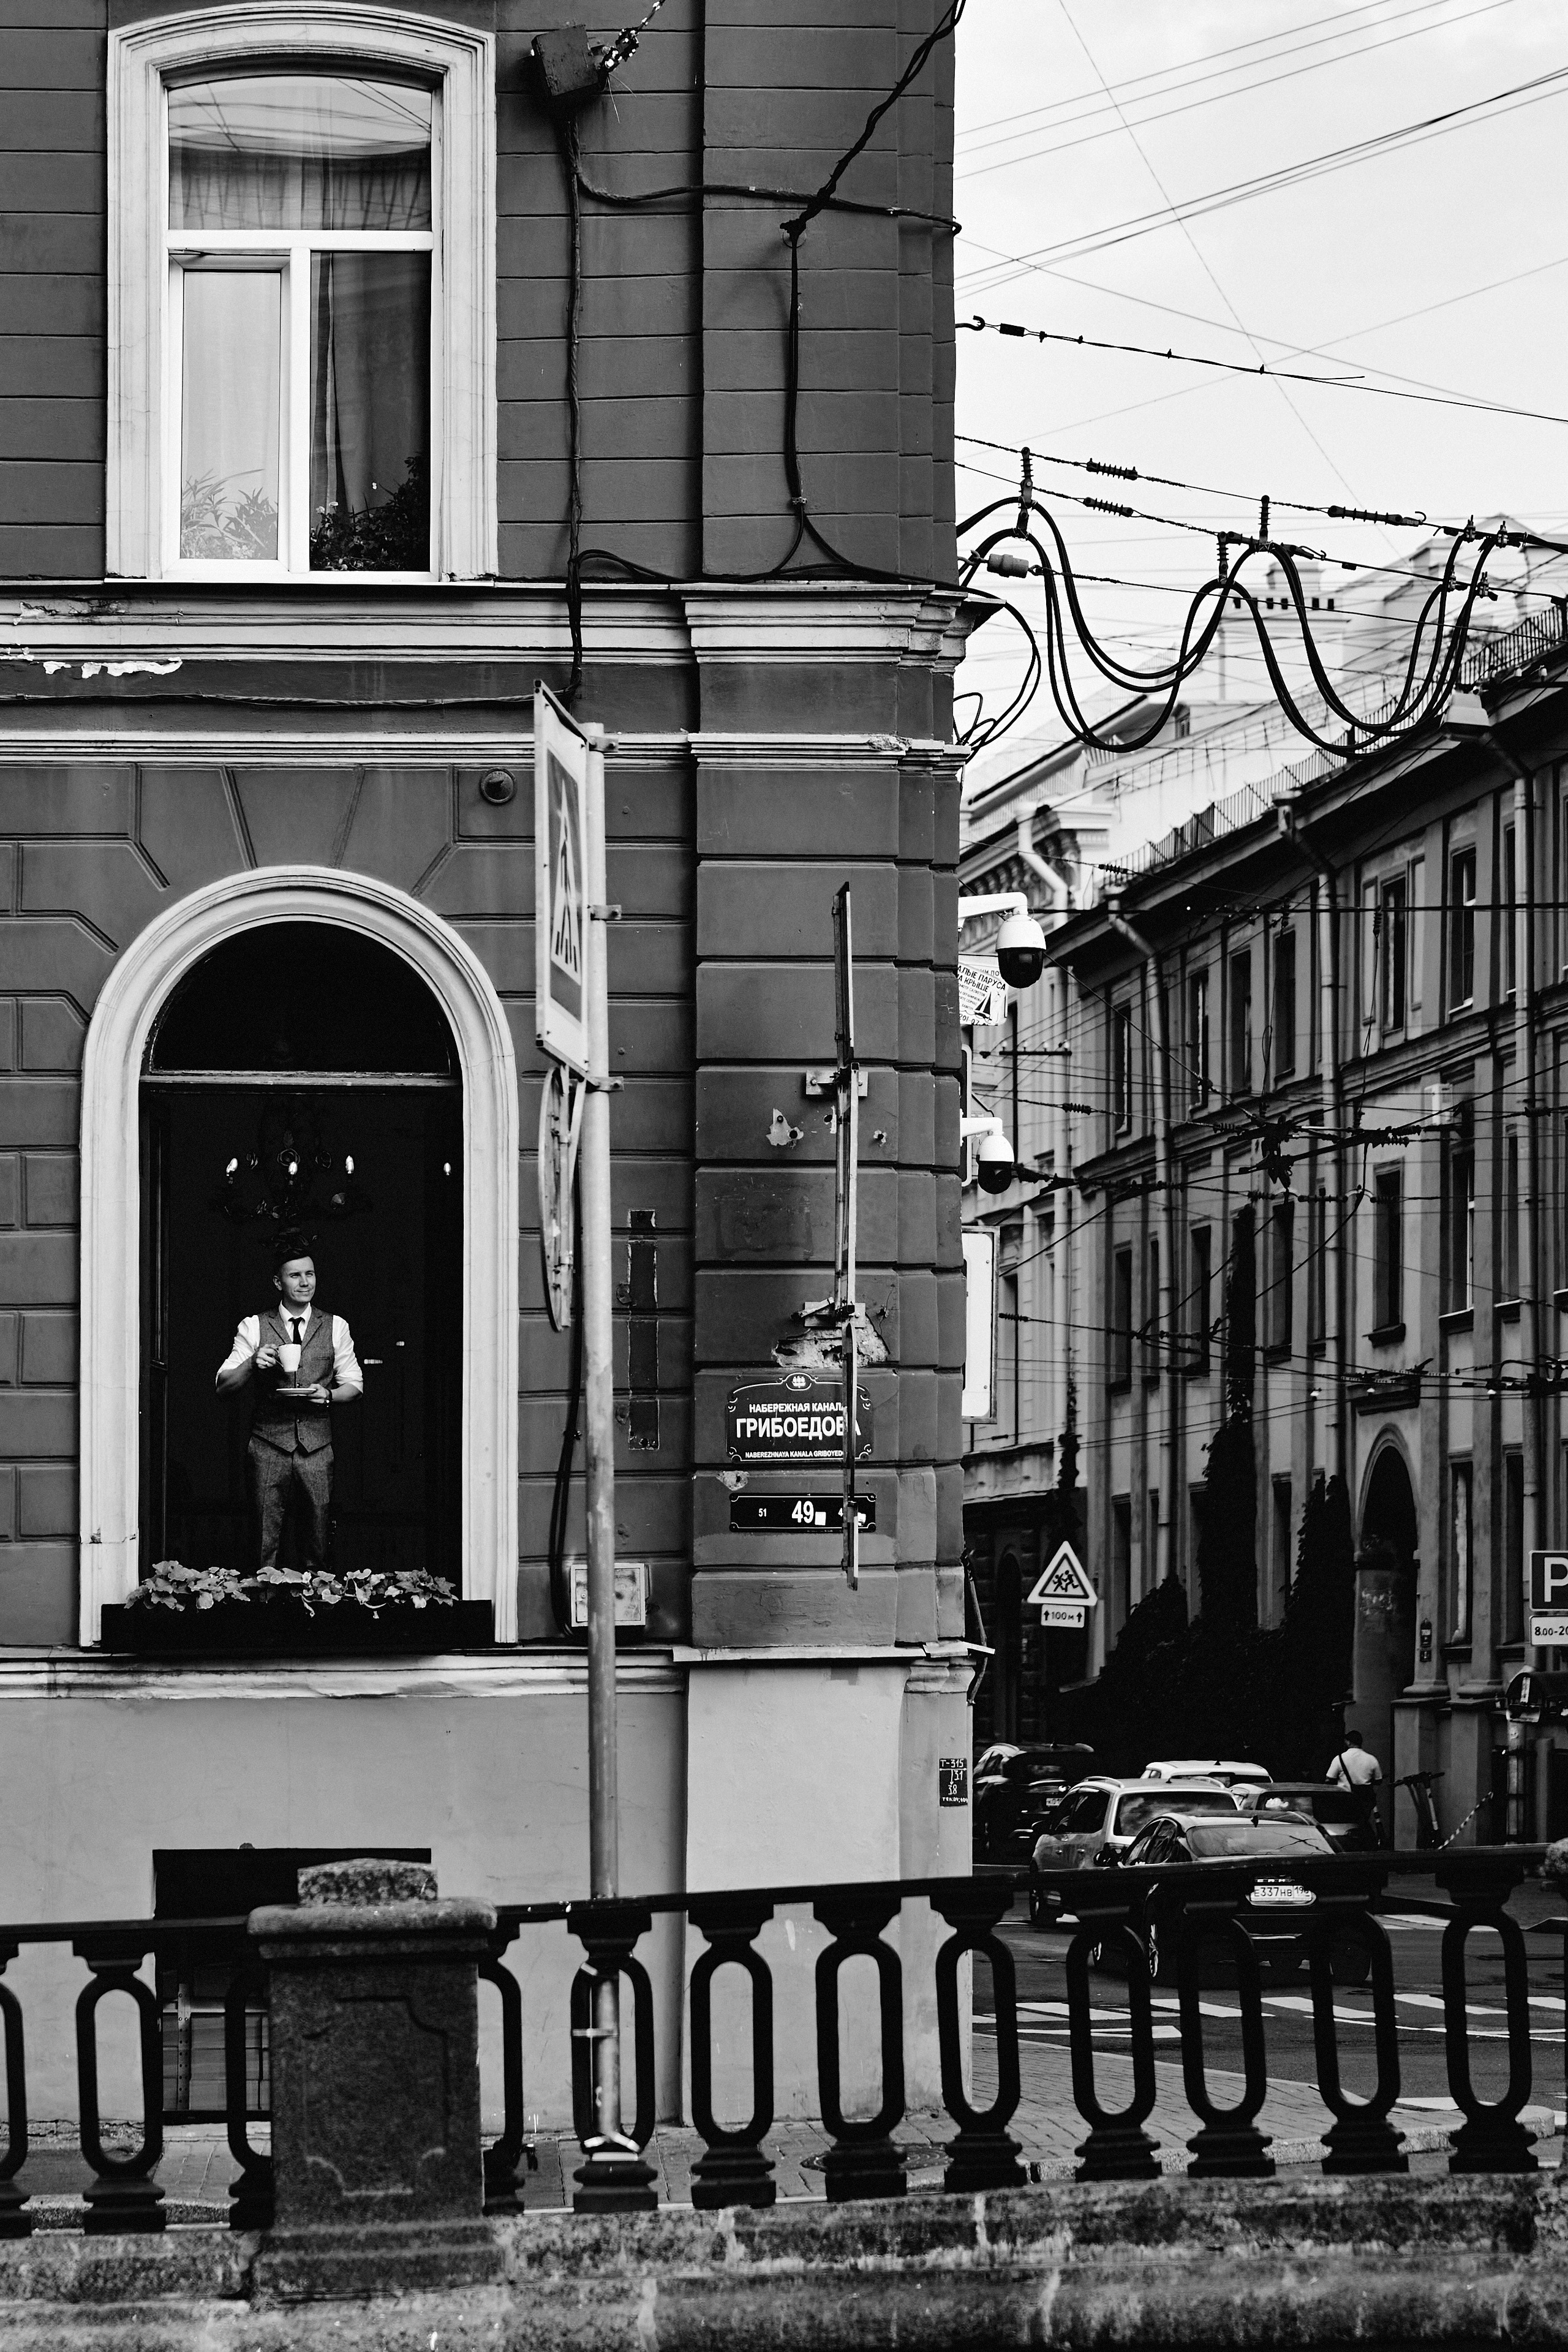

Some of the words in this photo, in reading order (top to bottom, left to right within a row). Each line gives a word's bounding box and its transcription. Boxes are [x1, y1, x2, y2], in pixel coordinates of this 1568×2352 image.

[964, 977, 989, 992] КРЫШЕ
[978, 974, 1006, 990] ПАРУСА
[749, 1403, 810, 1413] НАБЕРЕЖНАЯ
[812, 1402, 843, 1412] КАНАЛ
[758, 1508, 767, 1517] 51
[791, 1501, 814, 1523] 49
[1544, 1557, 1568, 1602] P
[1052, 1611, 1067, 1620] 100
